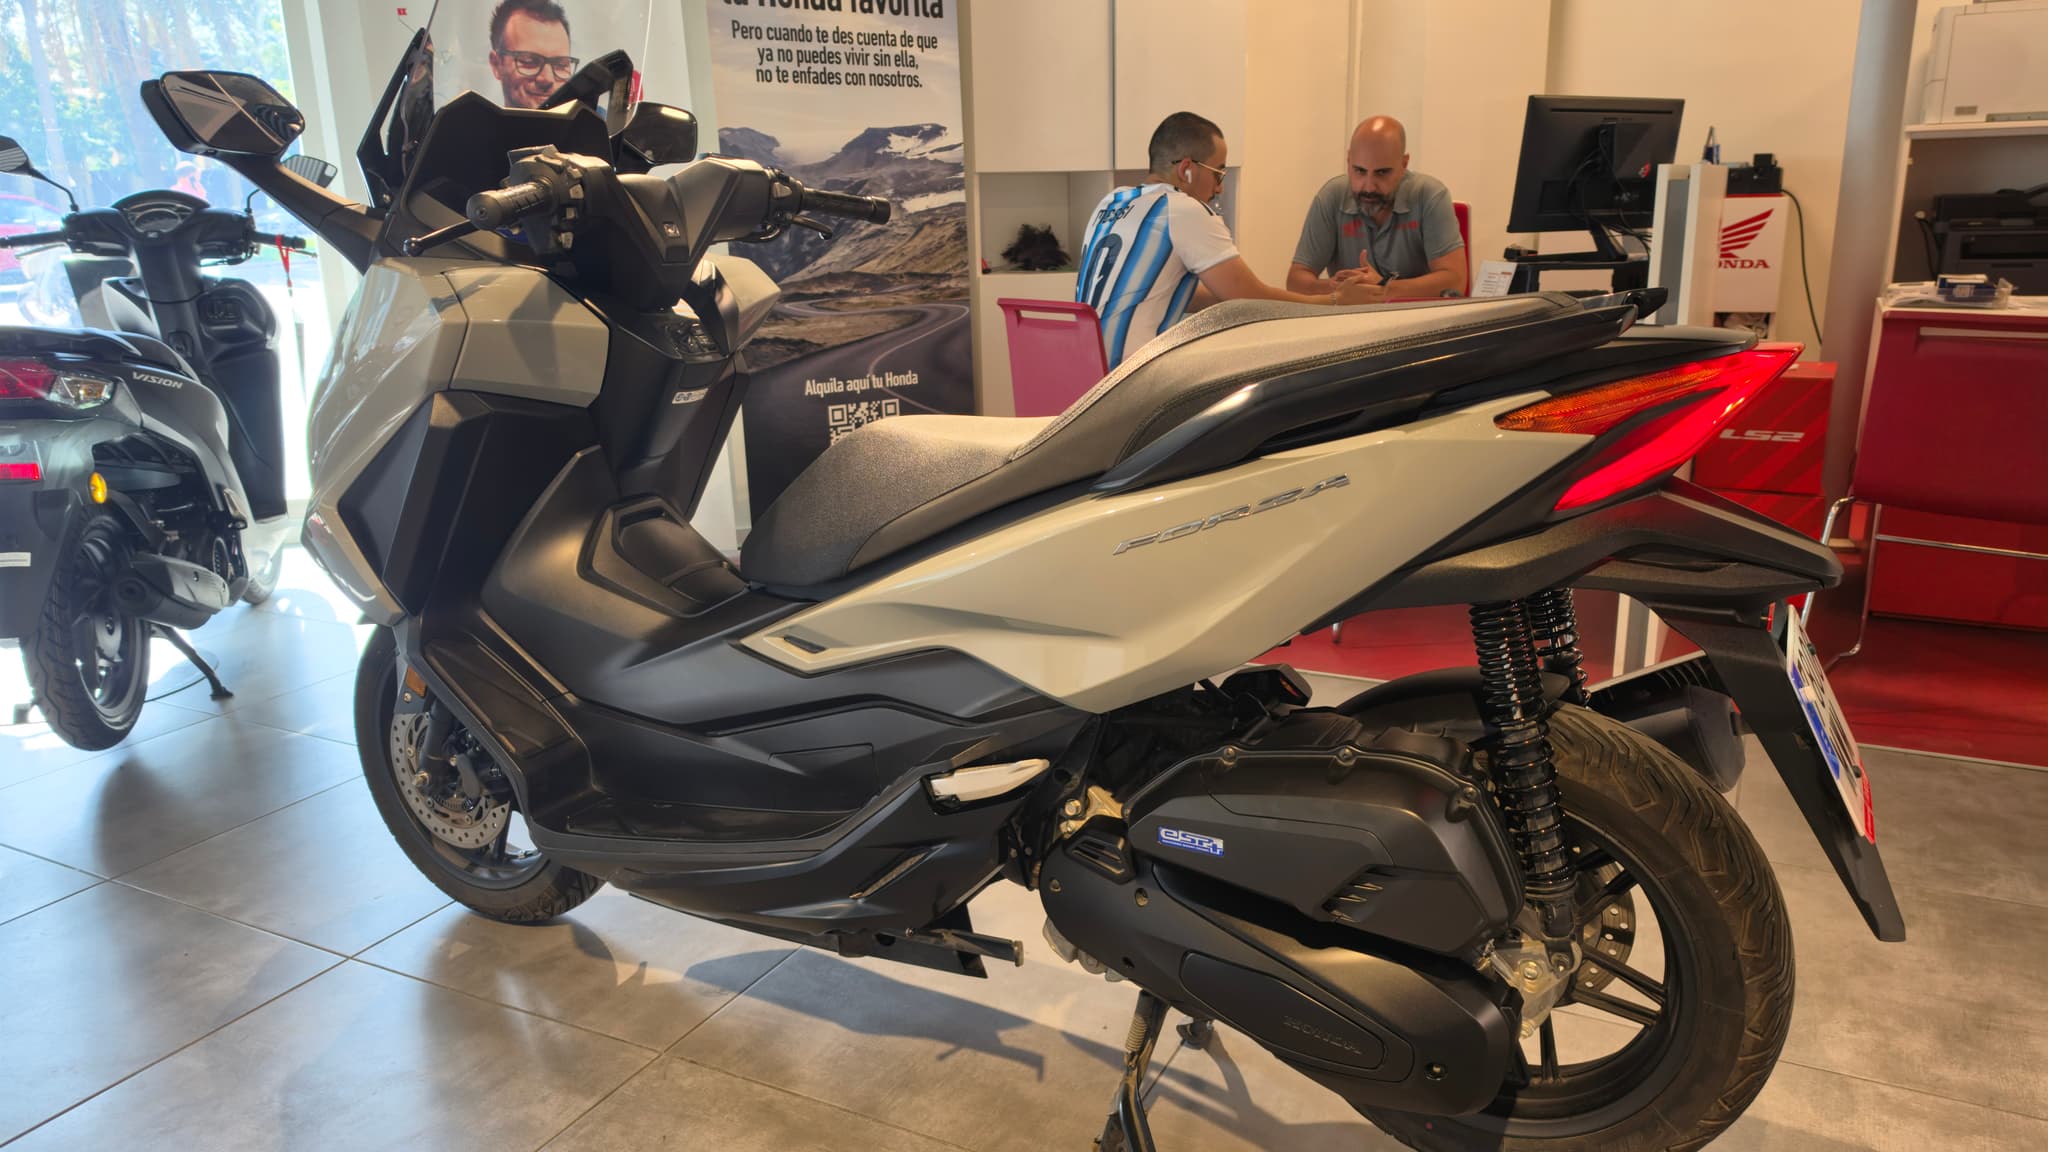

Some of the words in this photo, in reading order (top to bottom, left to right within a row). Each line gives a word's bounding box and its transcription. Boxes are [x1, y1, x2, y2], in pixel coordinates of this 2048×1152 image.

[731, 19, 763, 40] Pero
[766, 24, 813, 42] cuando
[816, 26, 829, 43] te
[832, 26, 854, 45] des
[856, 30, 897, 47] cuenta
[900, 30, 914, 48] de
[917, 34, 938, 53] que
[757, 47, 773, 65] ya
[777, 48, 793, 63] no
[796, 46, 842, 67] puedes
[844, 47, 870, 66] vivir
[873, 48, 891, 67] sin
[894, 50, 919, 69] ella,
[756, 68, 773, 82] no
[776, 66, 789, 83] te
[792, 66, 842, 85] enfades
[844, 71, 866, 86] con
[869, 70, 923, 88] nosotros.
[1718, 258, 1770, 270] NDA
[132, 371, 183, 390] VISION
[804, 377, 844, 398] Alquila
[846, 373, 870, 394] aquí
[871, 374, 883, 389] tu
[885, 369, 919, 388] Honda
[1719, 428, 1805, 443] LS2
